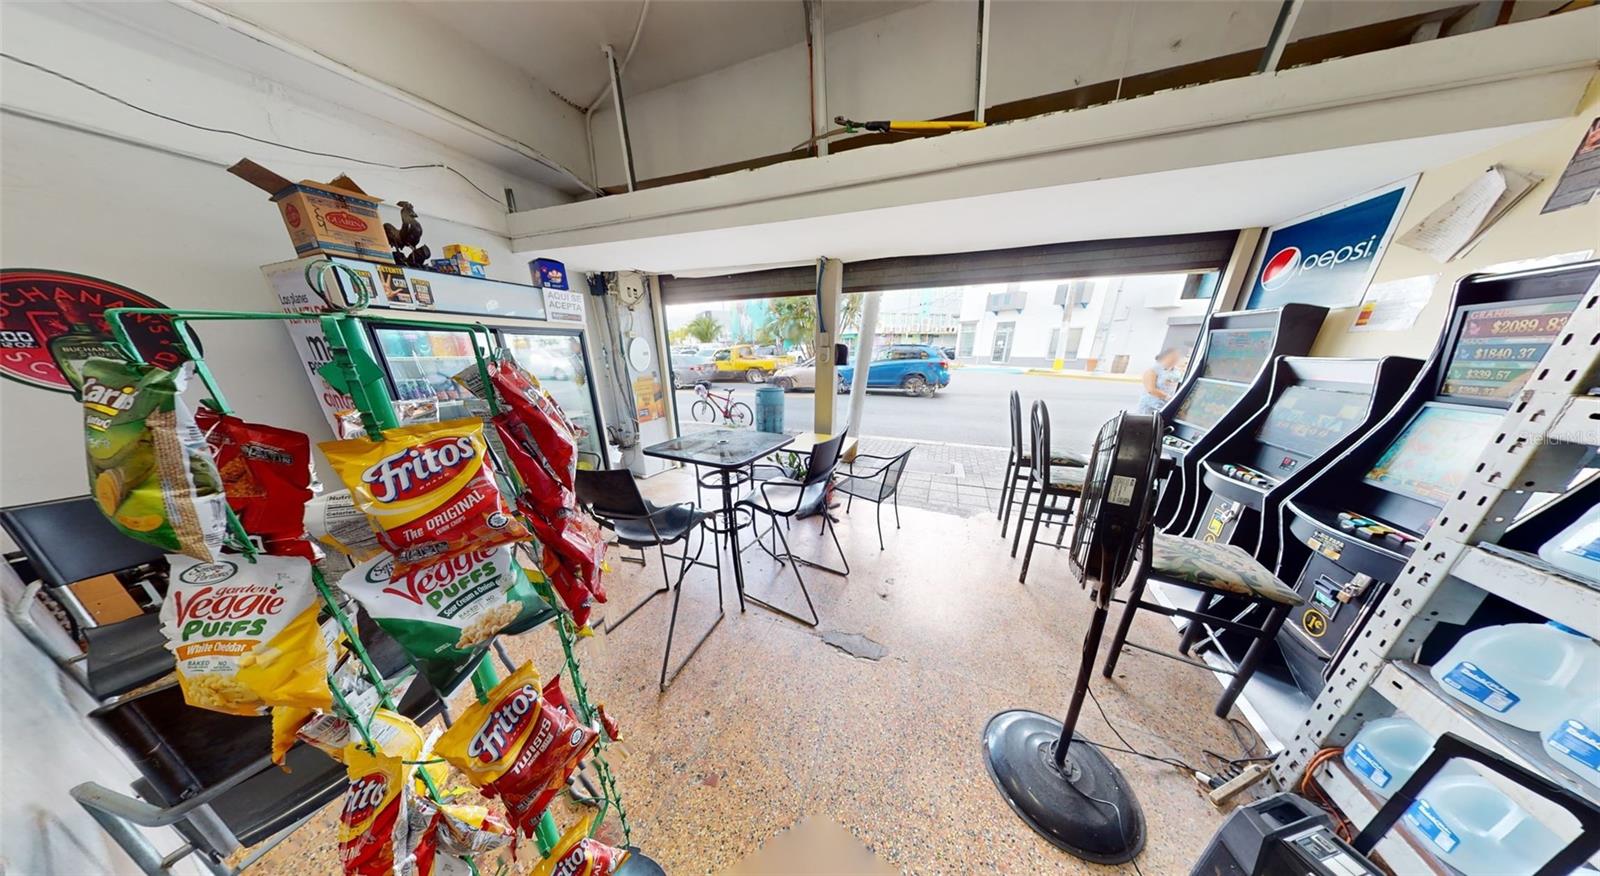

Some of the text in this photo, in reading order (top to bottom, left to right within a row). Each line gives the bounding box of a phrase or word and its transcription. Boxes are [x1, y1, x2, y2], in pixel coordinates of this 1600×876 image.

[1300, 235, 1374, 274] pepsi
[548, 300, 583, 313] ACEPTA
[1473, 347, 1537, 360] $1840.37
[361, 436, 476, 502] Fritos
[403, 489, 486, 542] The ORIGINAL
[426, 560, 497, 610] PUFFS
[443, 604, 459, 618] Sour
[457, 593, 476, 611] Cream
[174, 586, 285, 629] Veggie
[182, 618, 268, 642] PUFFS
[186, 641, 246, 656] White Cheddar
[467, 684, 539, 763] Fritos
[511, 717, 552, 775] TWISTS
